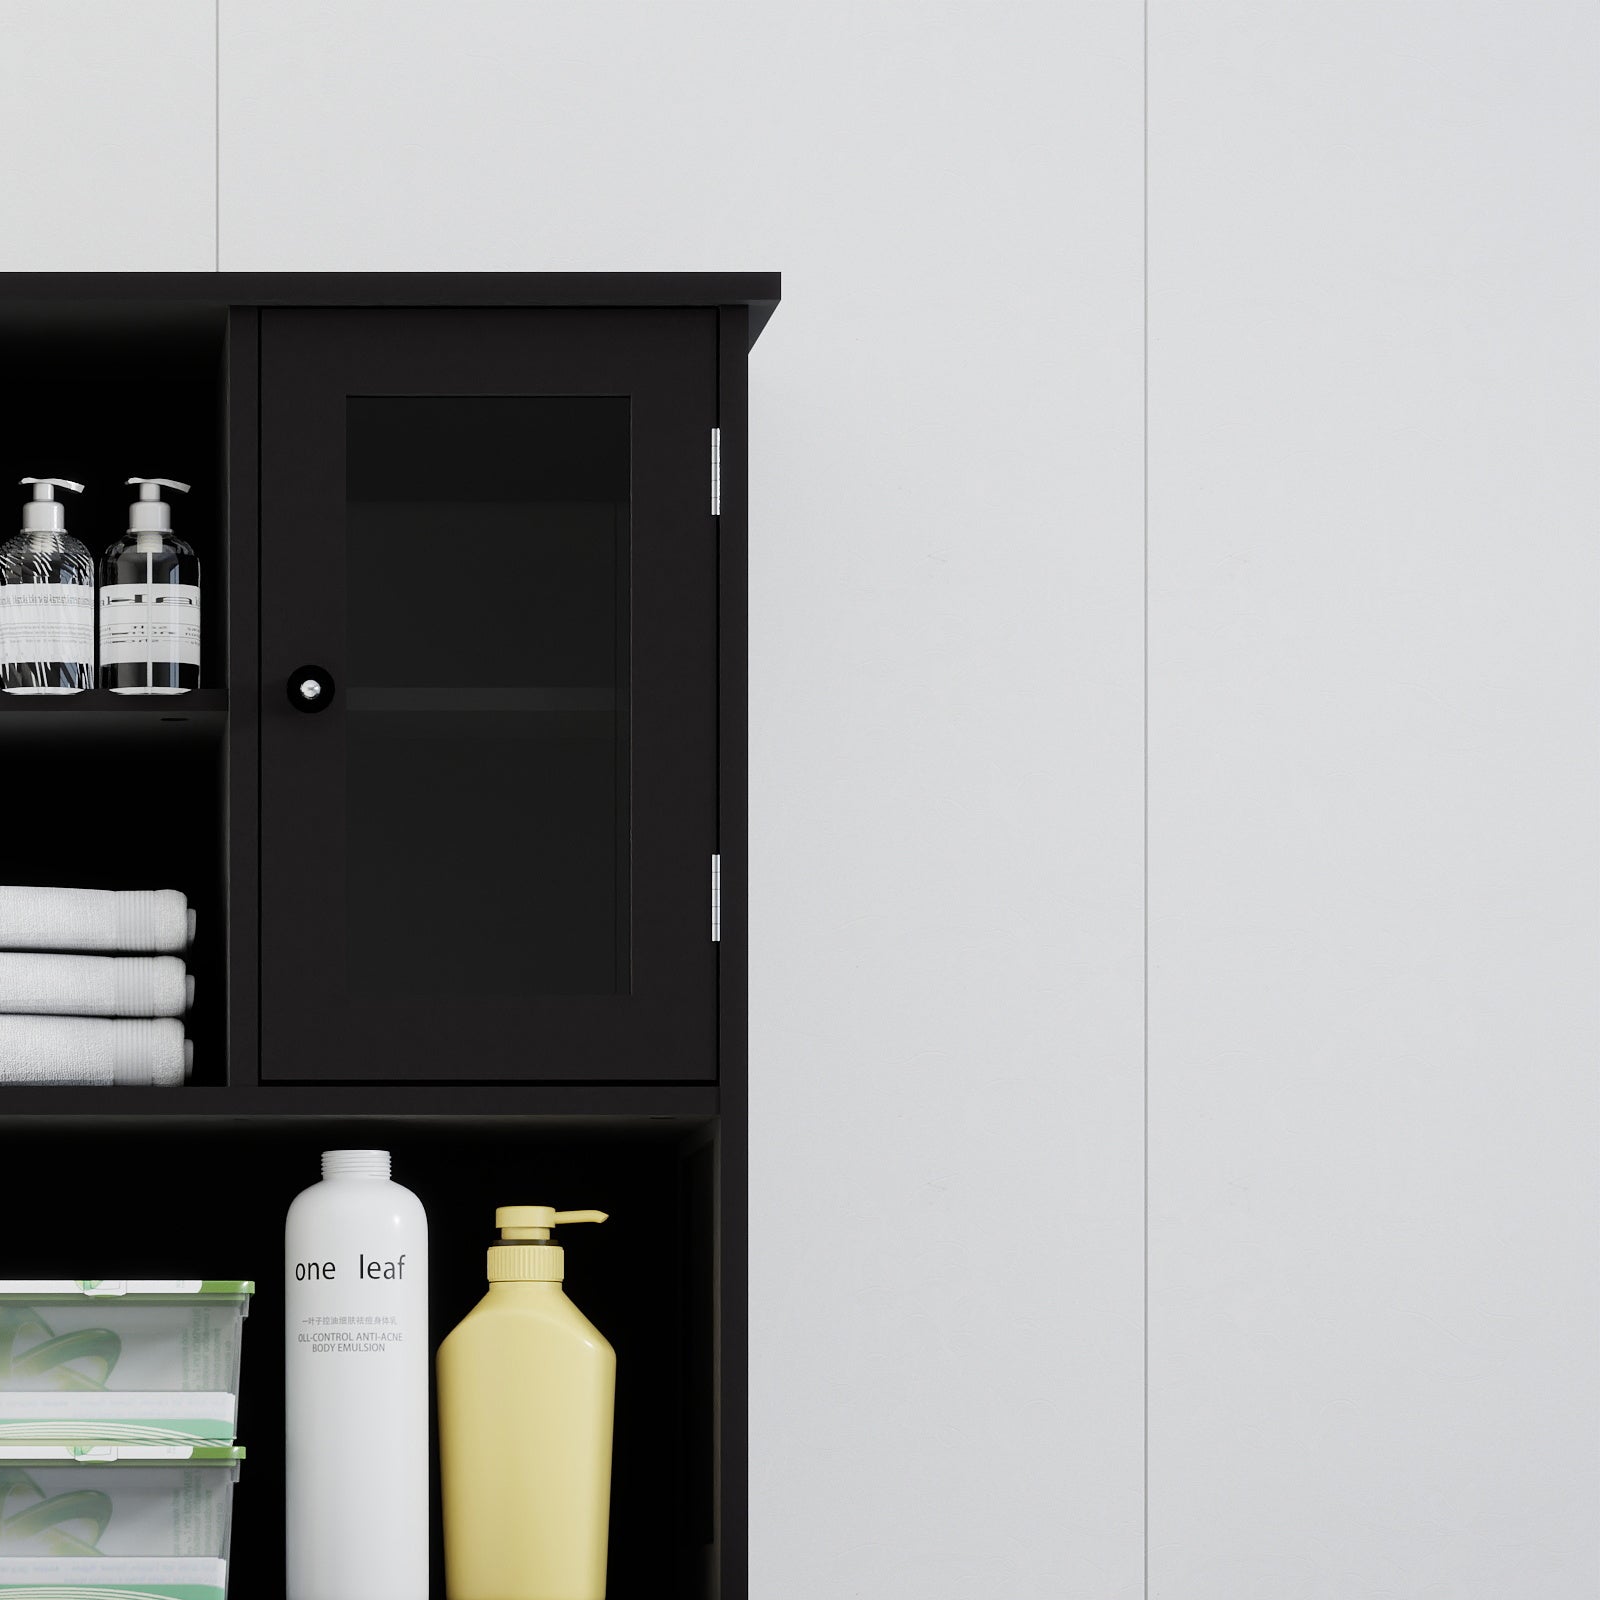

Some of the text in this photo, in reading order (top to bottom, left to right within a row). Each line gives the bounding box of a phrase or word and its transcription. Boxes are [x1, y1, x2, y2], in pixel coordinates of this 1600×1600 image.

[295, 1254, 406, 1281] one leaf
[312, 1343, 386, 1353] BODY EMULSION
